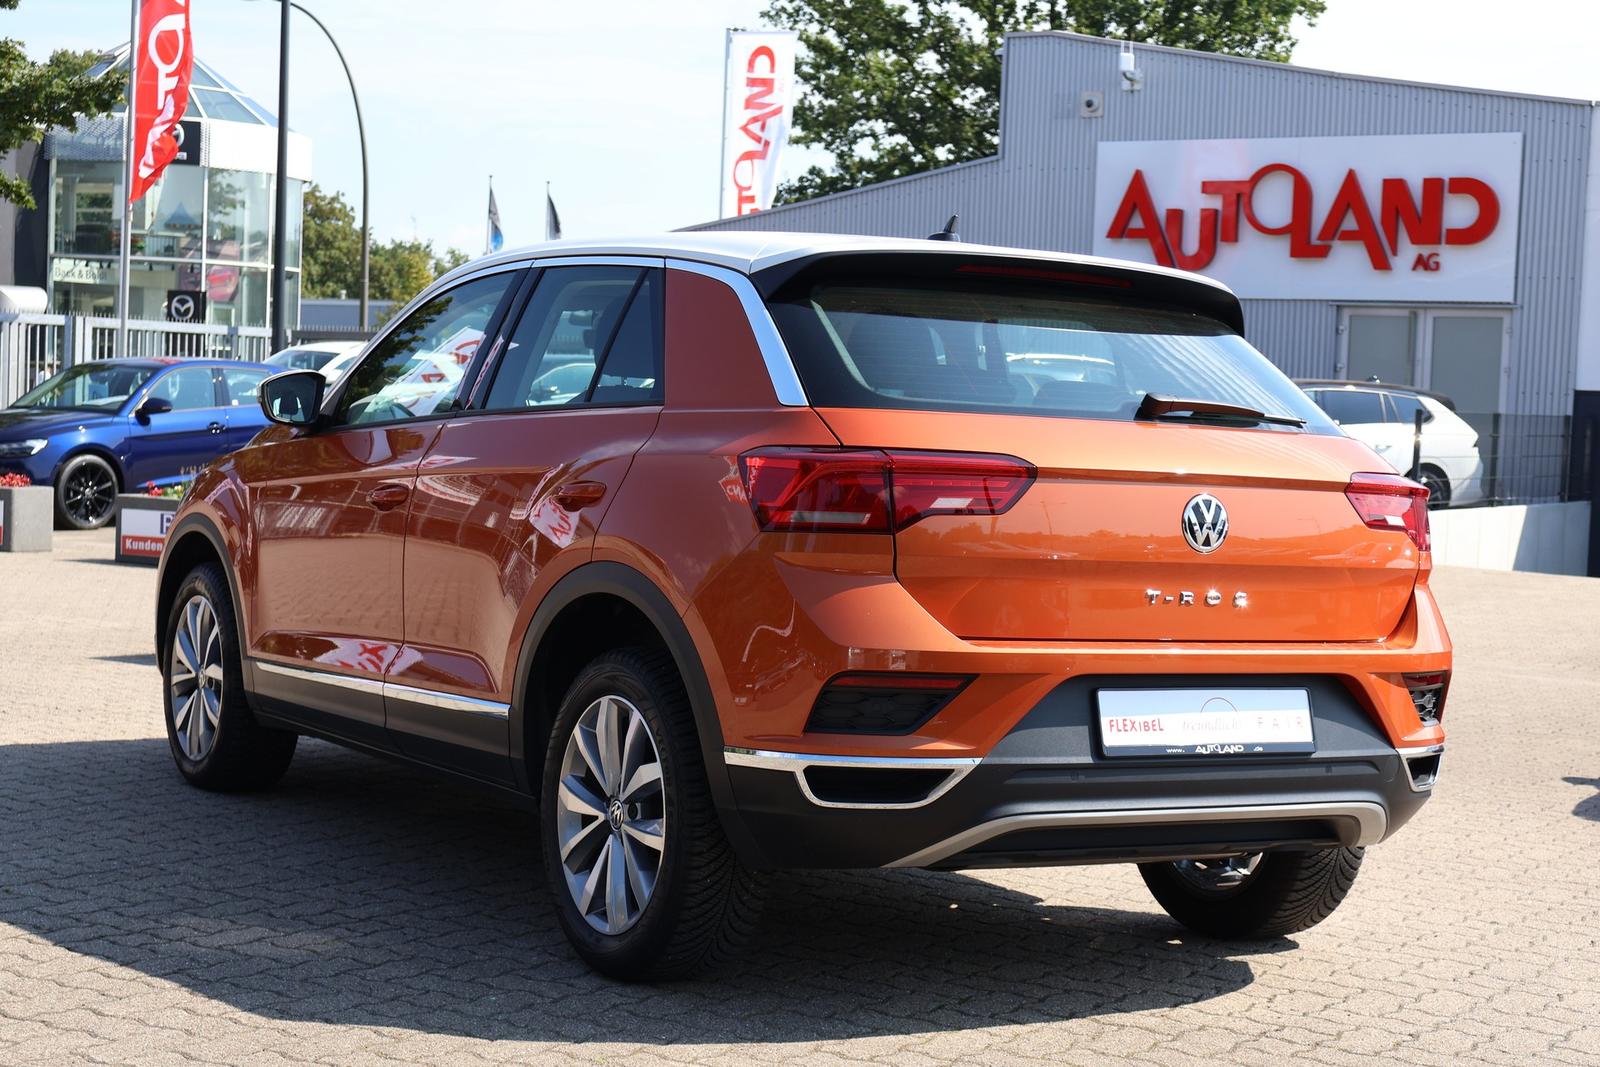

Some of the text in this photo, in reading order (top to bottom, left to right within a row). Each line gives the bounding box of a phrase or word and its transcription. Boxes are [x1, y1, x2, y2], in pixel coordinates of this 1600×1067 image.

[733, 45, 784, 217] TOLAND
[1106, 164, 1501, 271] AUTOLAND
[1412, 252, 1441, 272] AG
[1183, 494, 1228, 553] VW
[1195, 744, 1244, 754] AUTOLAND
